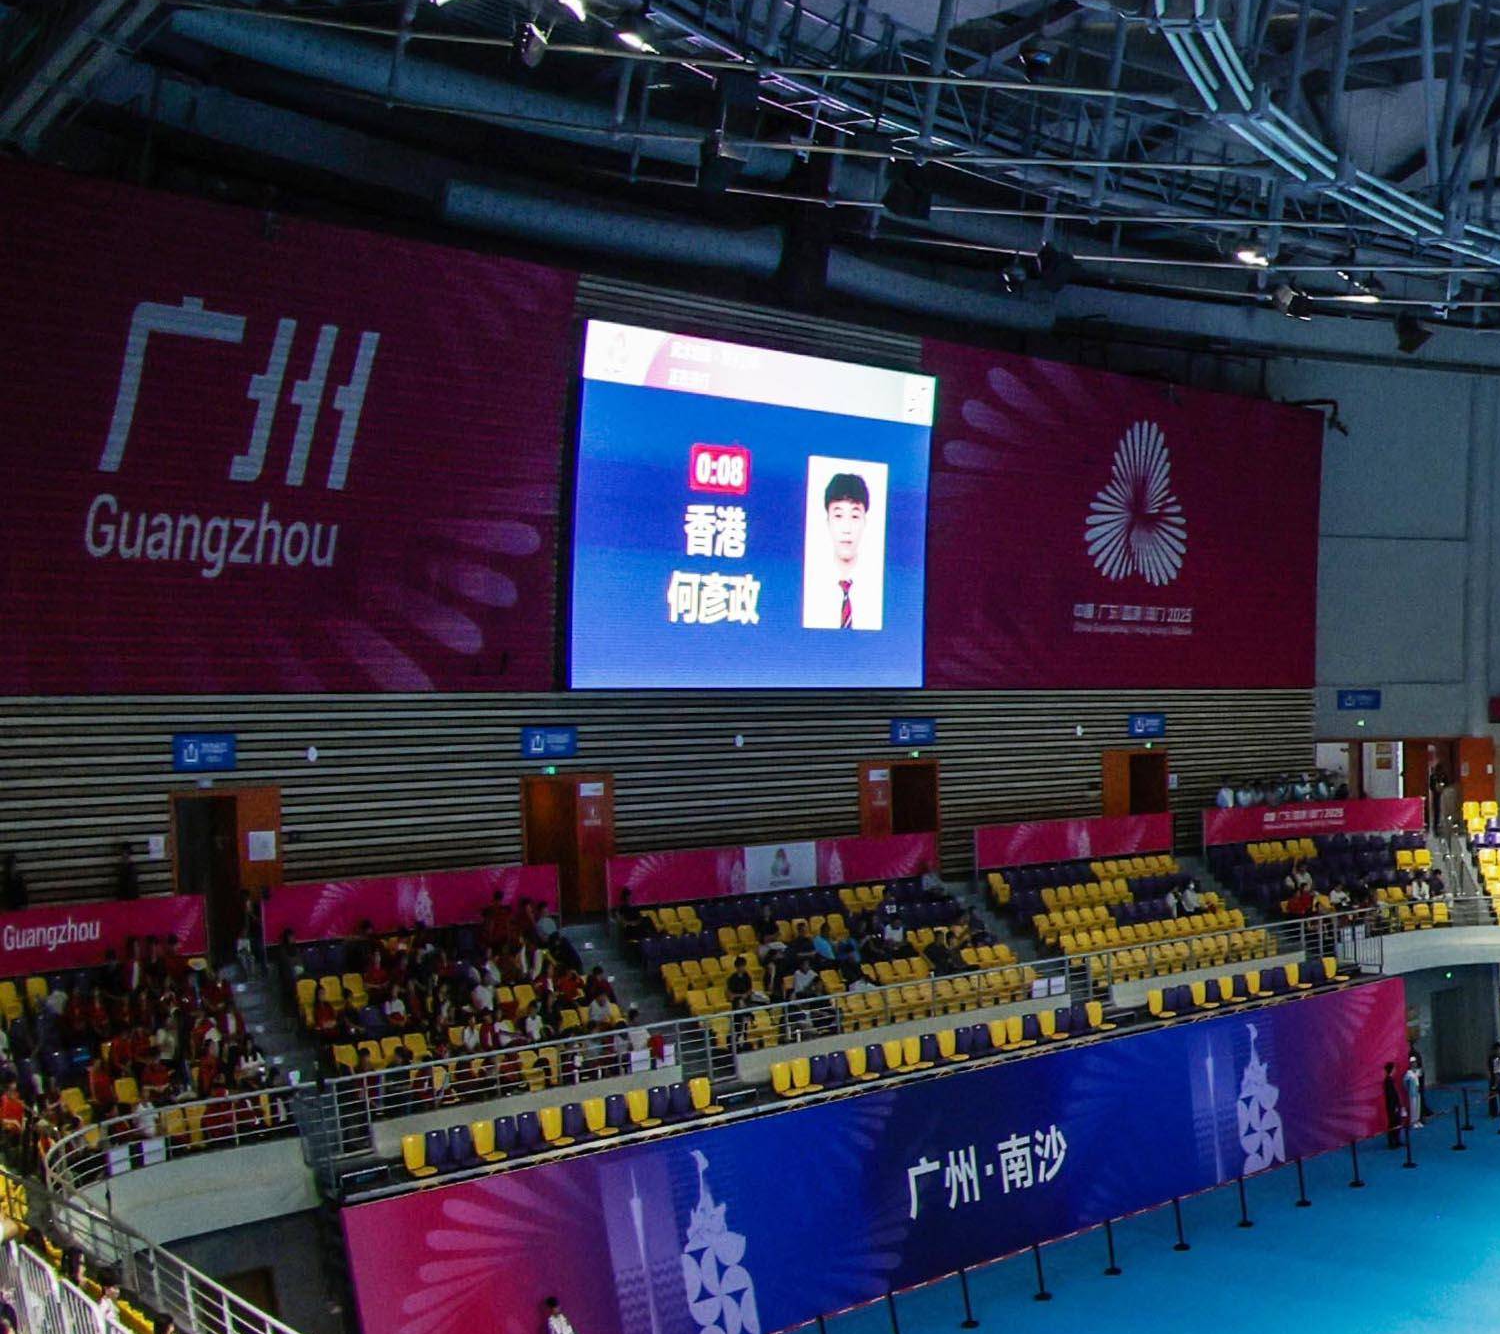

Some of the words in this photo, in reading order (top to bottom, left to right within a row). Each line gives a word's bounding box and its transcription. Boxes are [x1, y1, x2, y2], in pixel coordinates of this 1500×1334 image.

[98, 296, 381, 491] 广州
[696, 452, 744, 486] 0:08
[85, 493, 338, 578] Guangzhou
[684, 504, 746, 557] 香港
[4, 919, 101, 953] Guangzhou
[907, 1125, 1067, 1219] 广州·南沙
